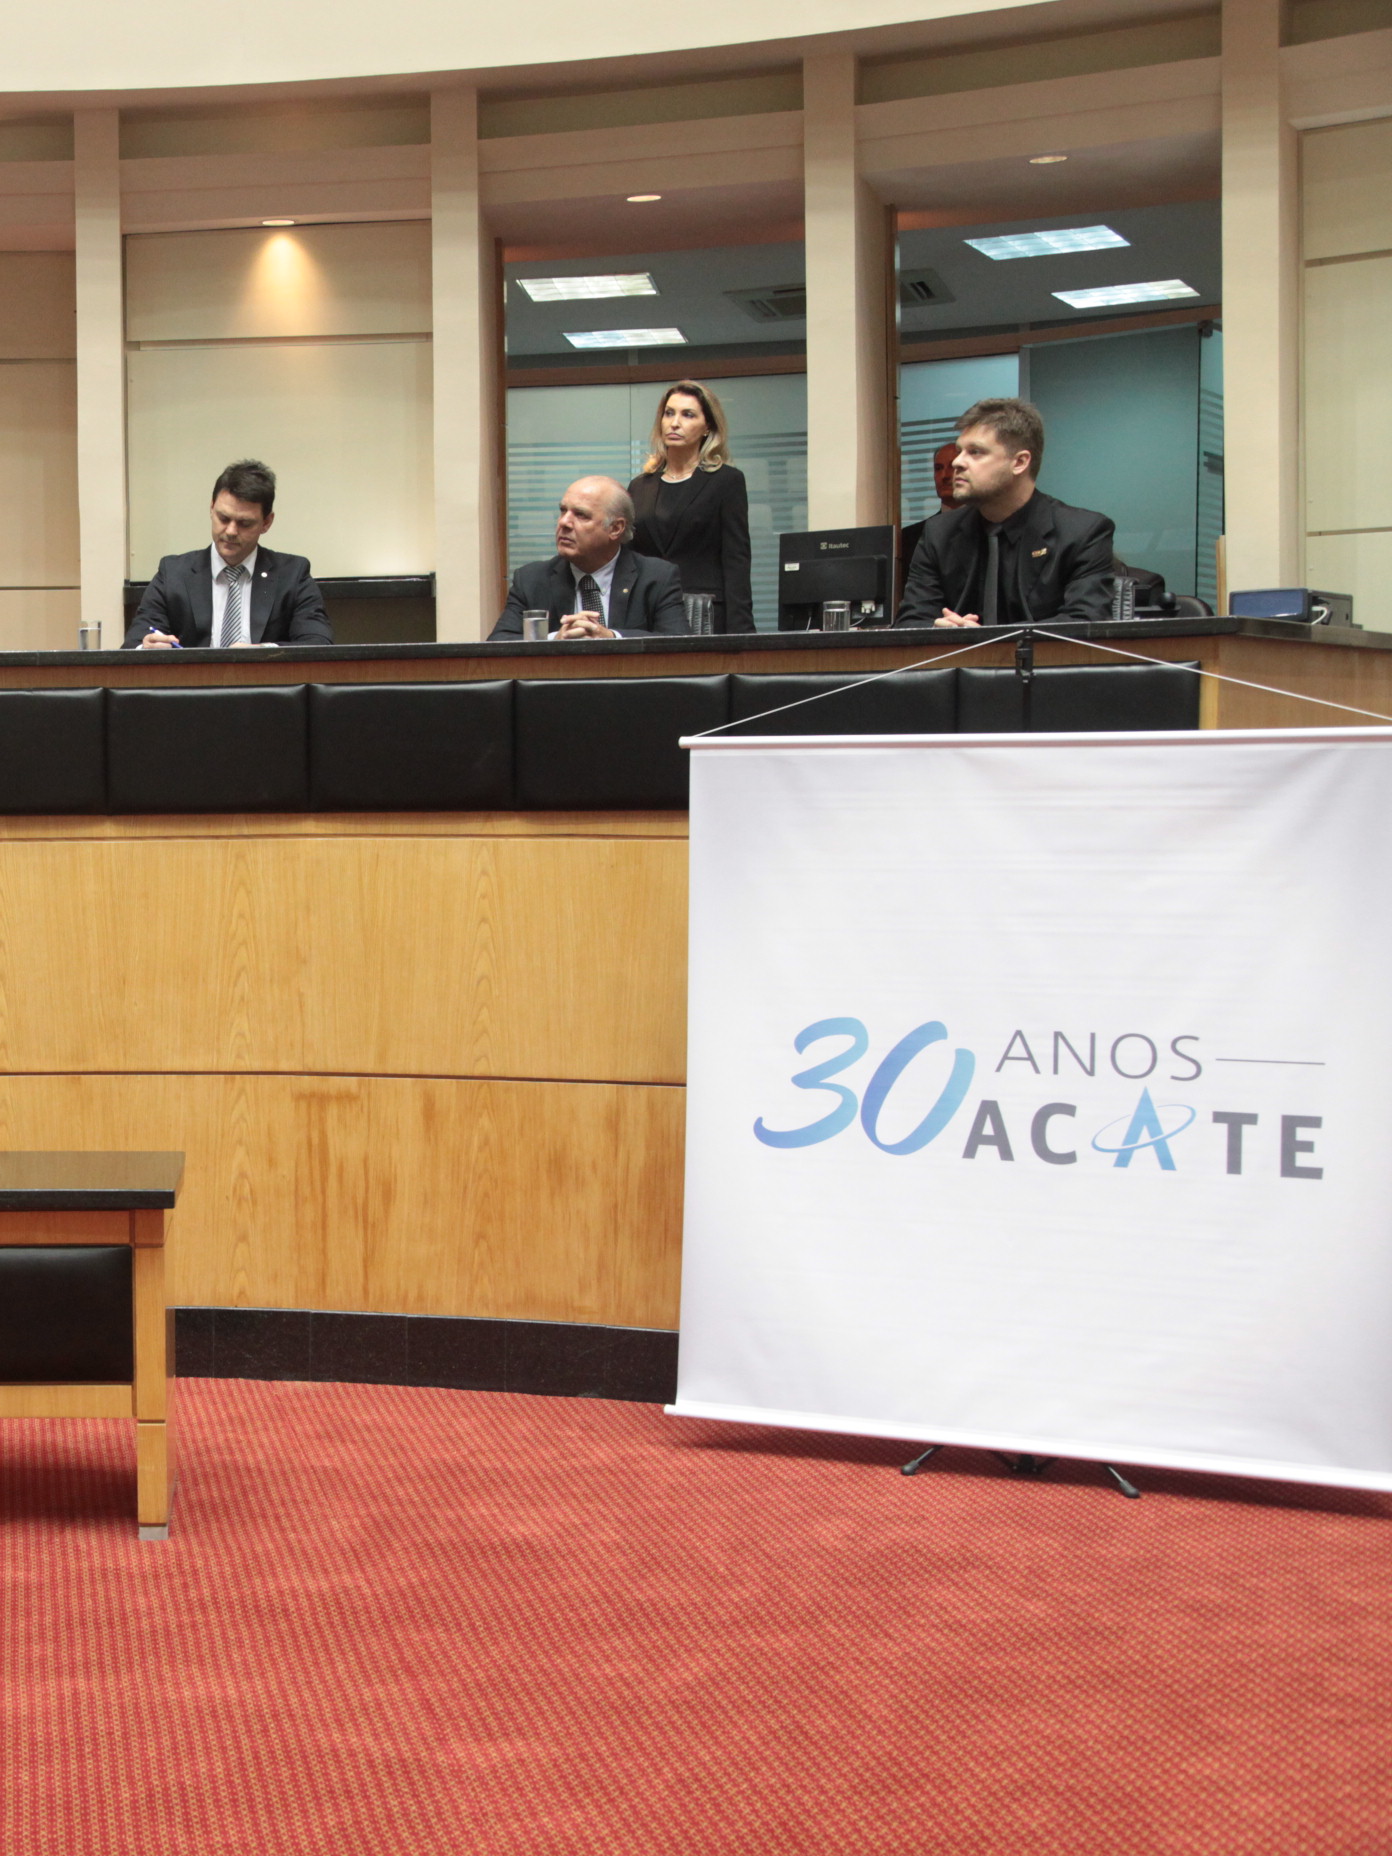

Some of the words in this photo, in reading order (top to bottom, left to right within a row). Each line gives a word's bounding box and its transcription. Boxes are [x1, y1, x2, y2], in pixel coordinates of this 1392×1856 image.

[753, 1017, 976, 1156] 30
[994, 1029, 1203, 1082] ANOS
[961, 1085, 1324, 1181] ACATE
